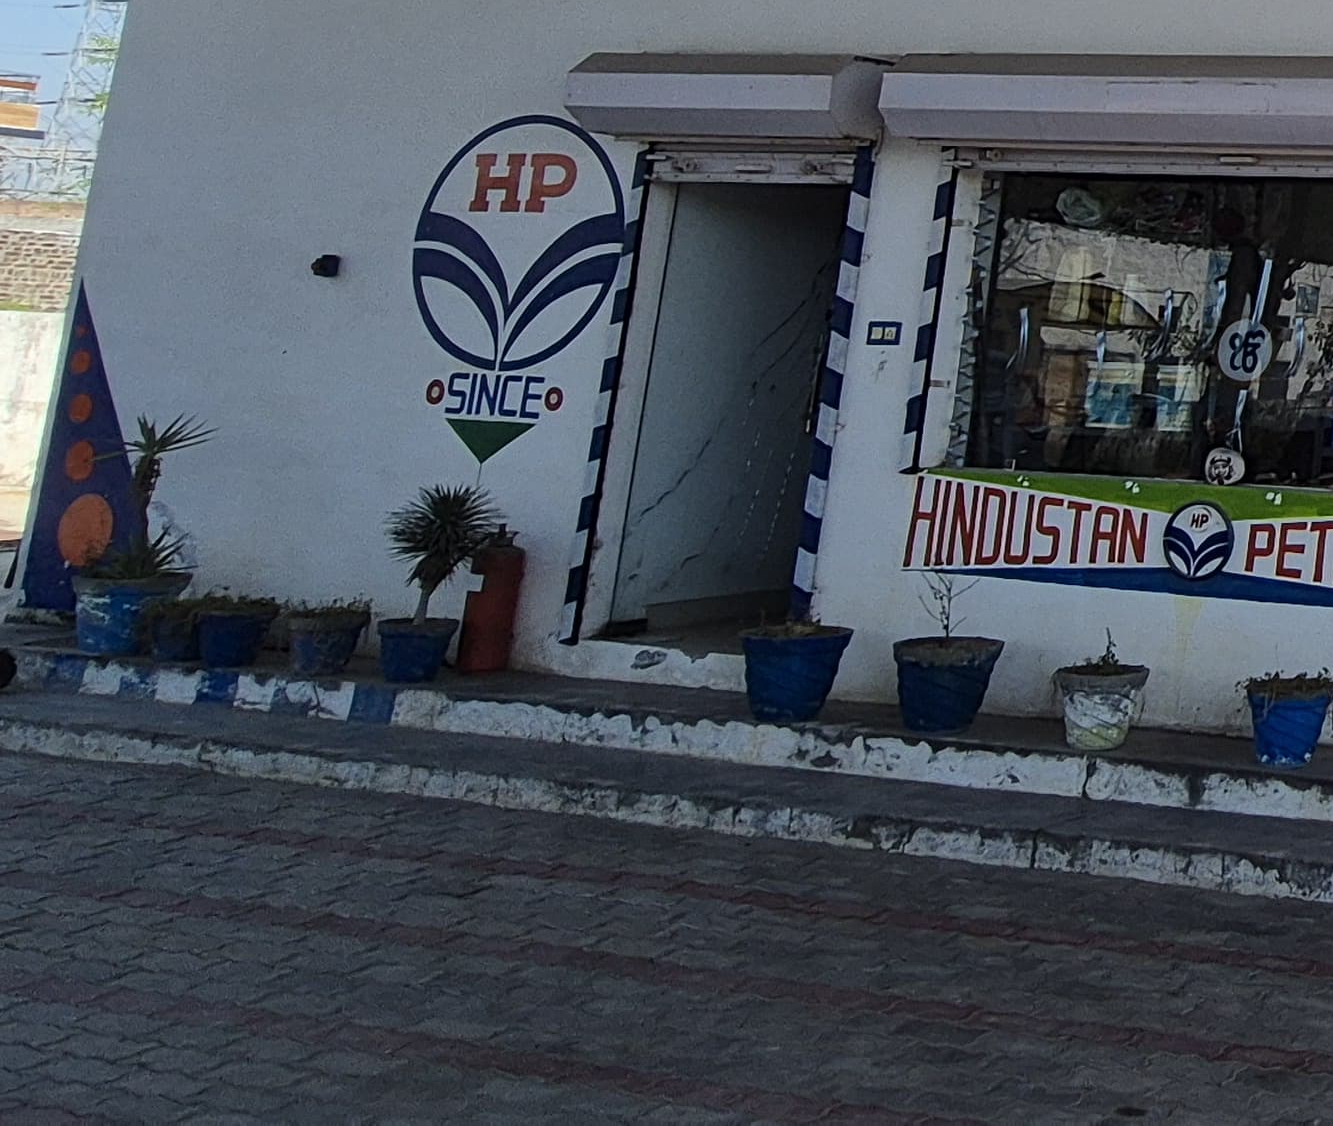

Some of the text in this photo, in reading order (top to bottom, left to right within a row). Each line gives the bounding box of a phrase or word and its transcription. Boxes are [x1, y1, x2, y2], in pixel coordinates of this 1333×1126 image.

[468, 153, 578, 213] HP
[444, 373, 545, 419] SINCE
[903, 475, 1148, 568] HINDUSTAN
[1190, 513, 1210, 529] HP
